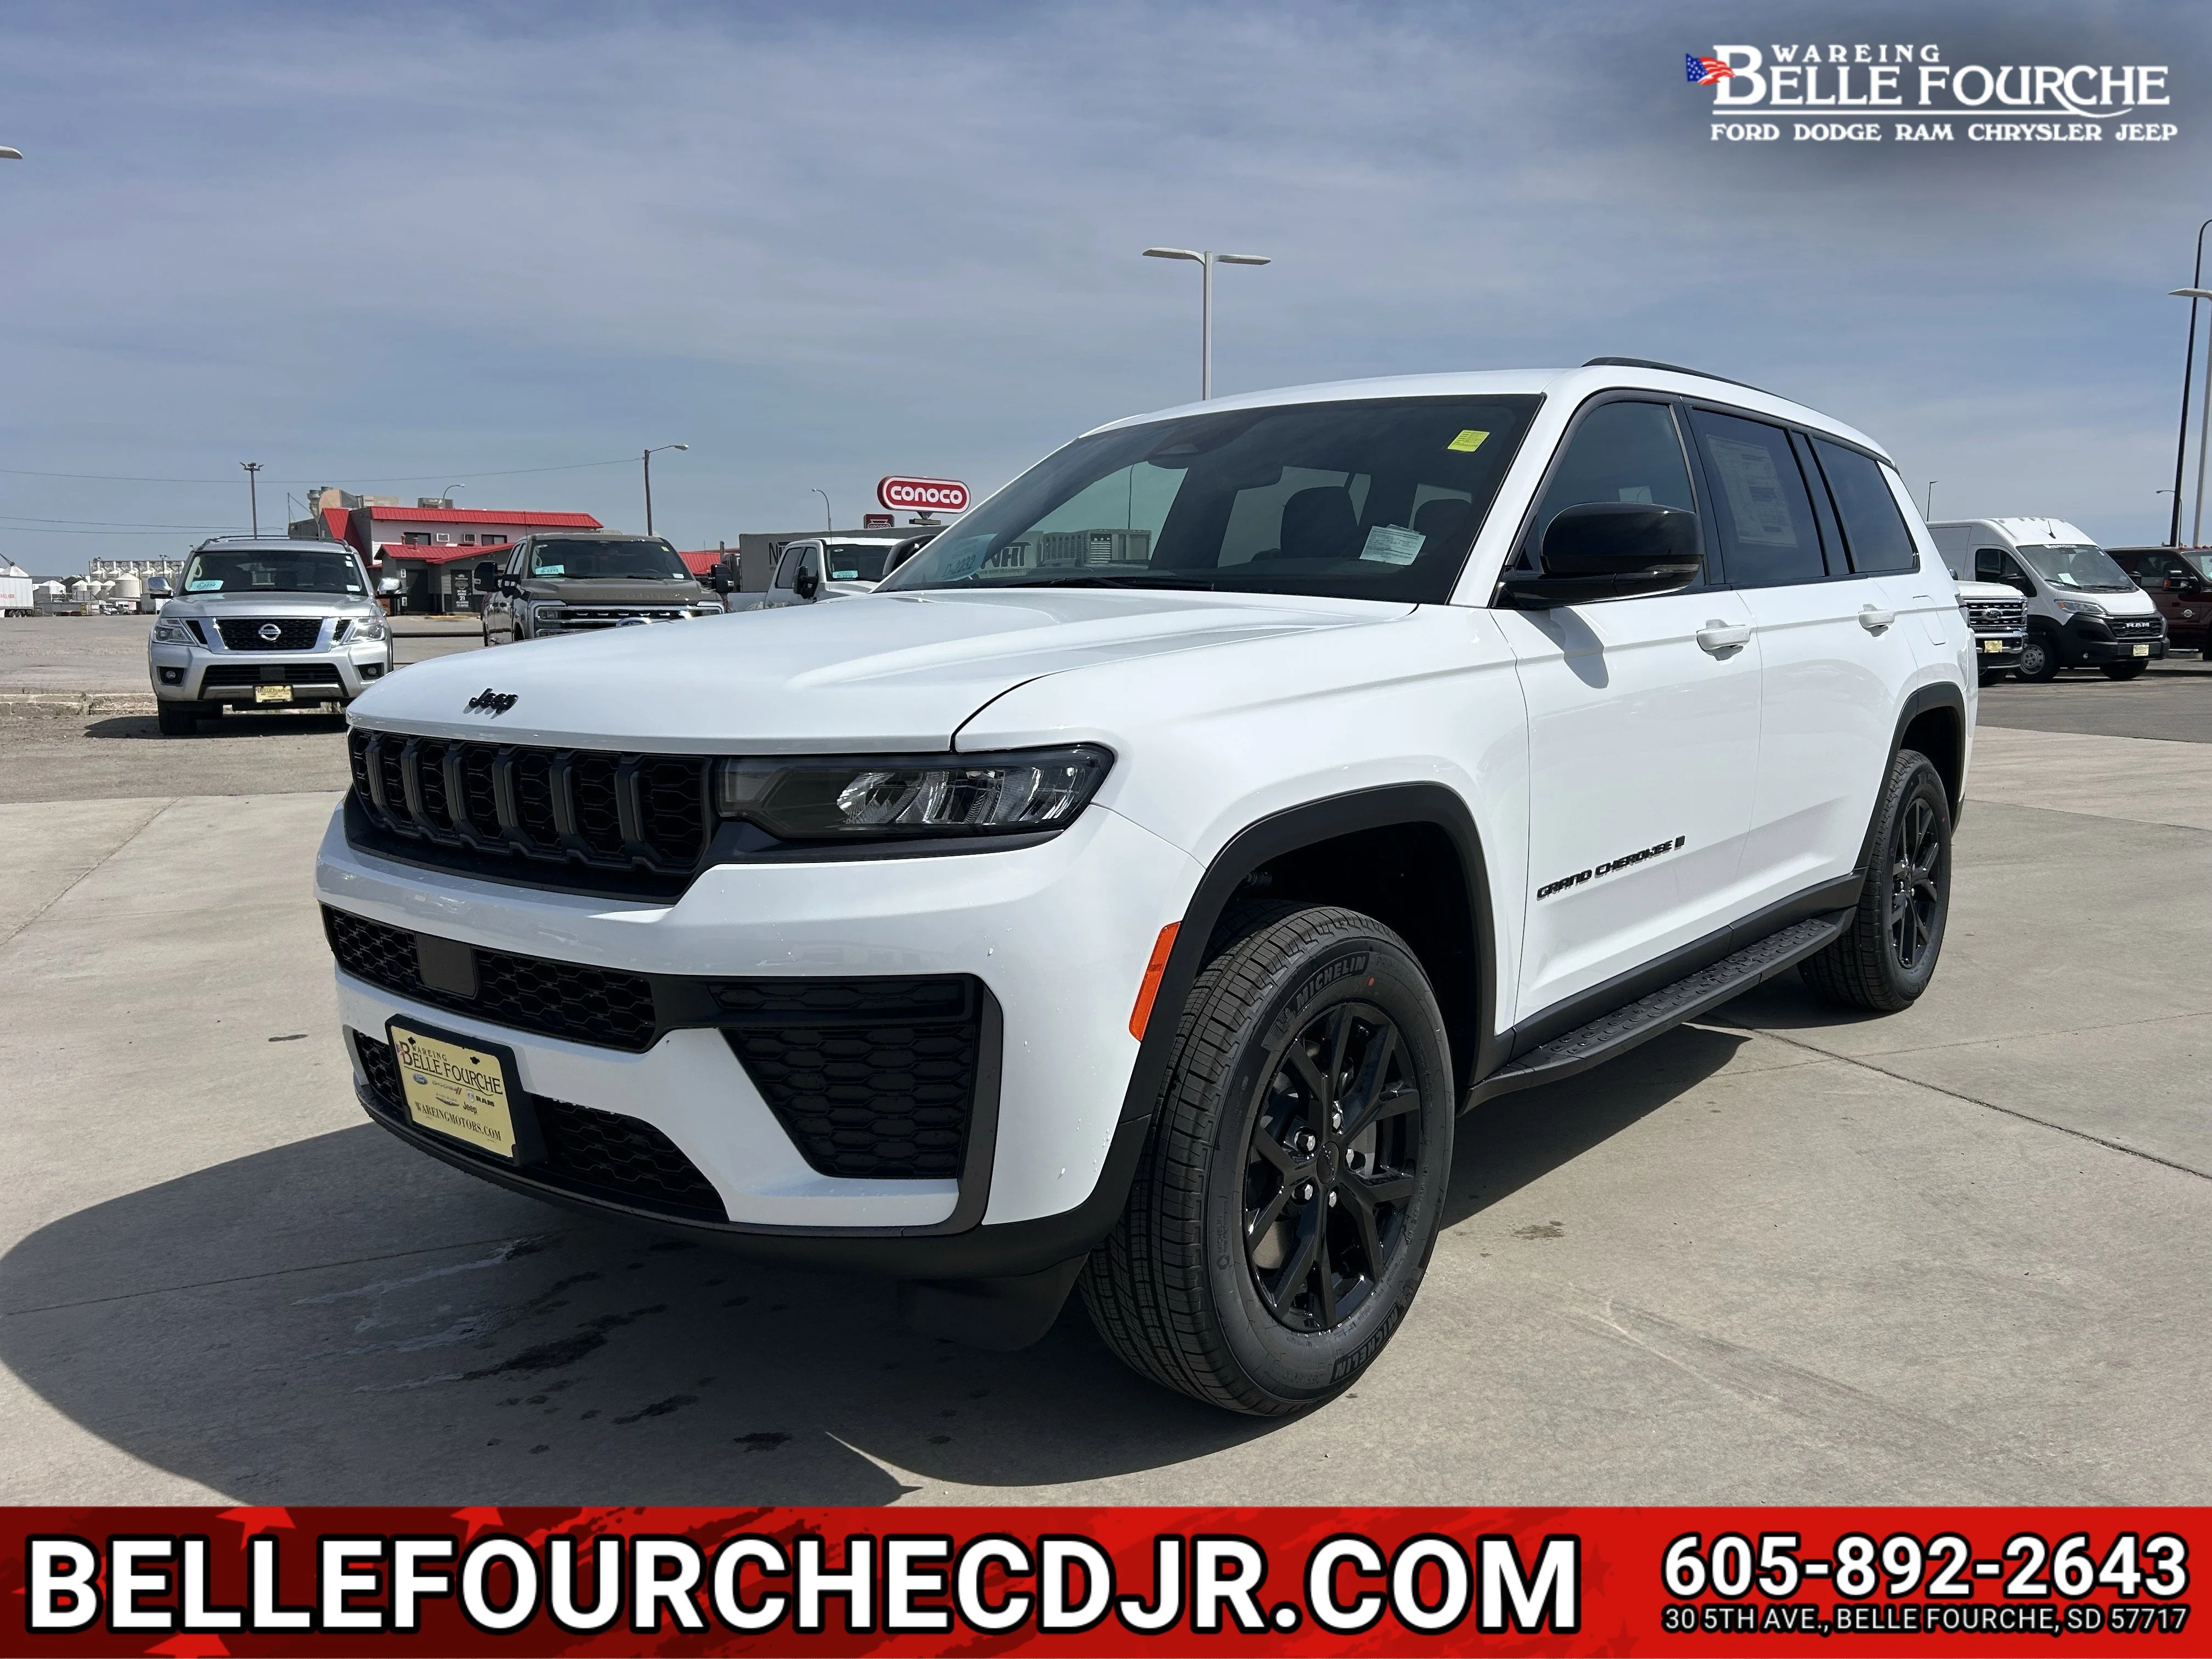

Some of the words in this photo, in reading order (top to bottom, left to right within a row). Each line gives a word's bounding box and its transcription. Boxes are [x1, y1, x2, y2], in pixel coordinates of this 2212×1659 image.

[890, 485, 963, 505] CONOCO
[469, 688, 519, 714] Jeep
[1537, 869, 1592, 899] GRAND
[1595, 840, 1673, 876] CHEROKEE
[1296, 956, 1366, 1011] MICHELIN
[399, 1040, 443, 1076] BELLE
[443, 1062, 503, 1097] FOURCHE
[412, 1044, 448, 1062] WAREING
[462, 1101, 478, 1115] Jeep
[475, 1095, 495, 1107] RAM
[414, 1101, 502, 1142] WAREINGMOTORS.COM
[1335, 1307, 1399, 1380] MICHELIN
